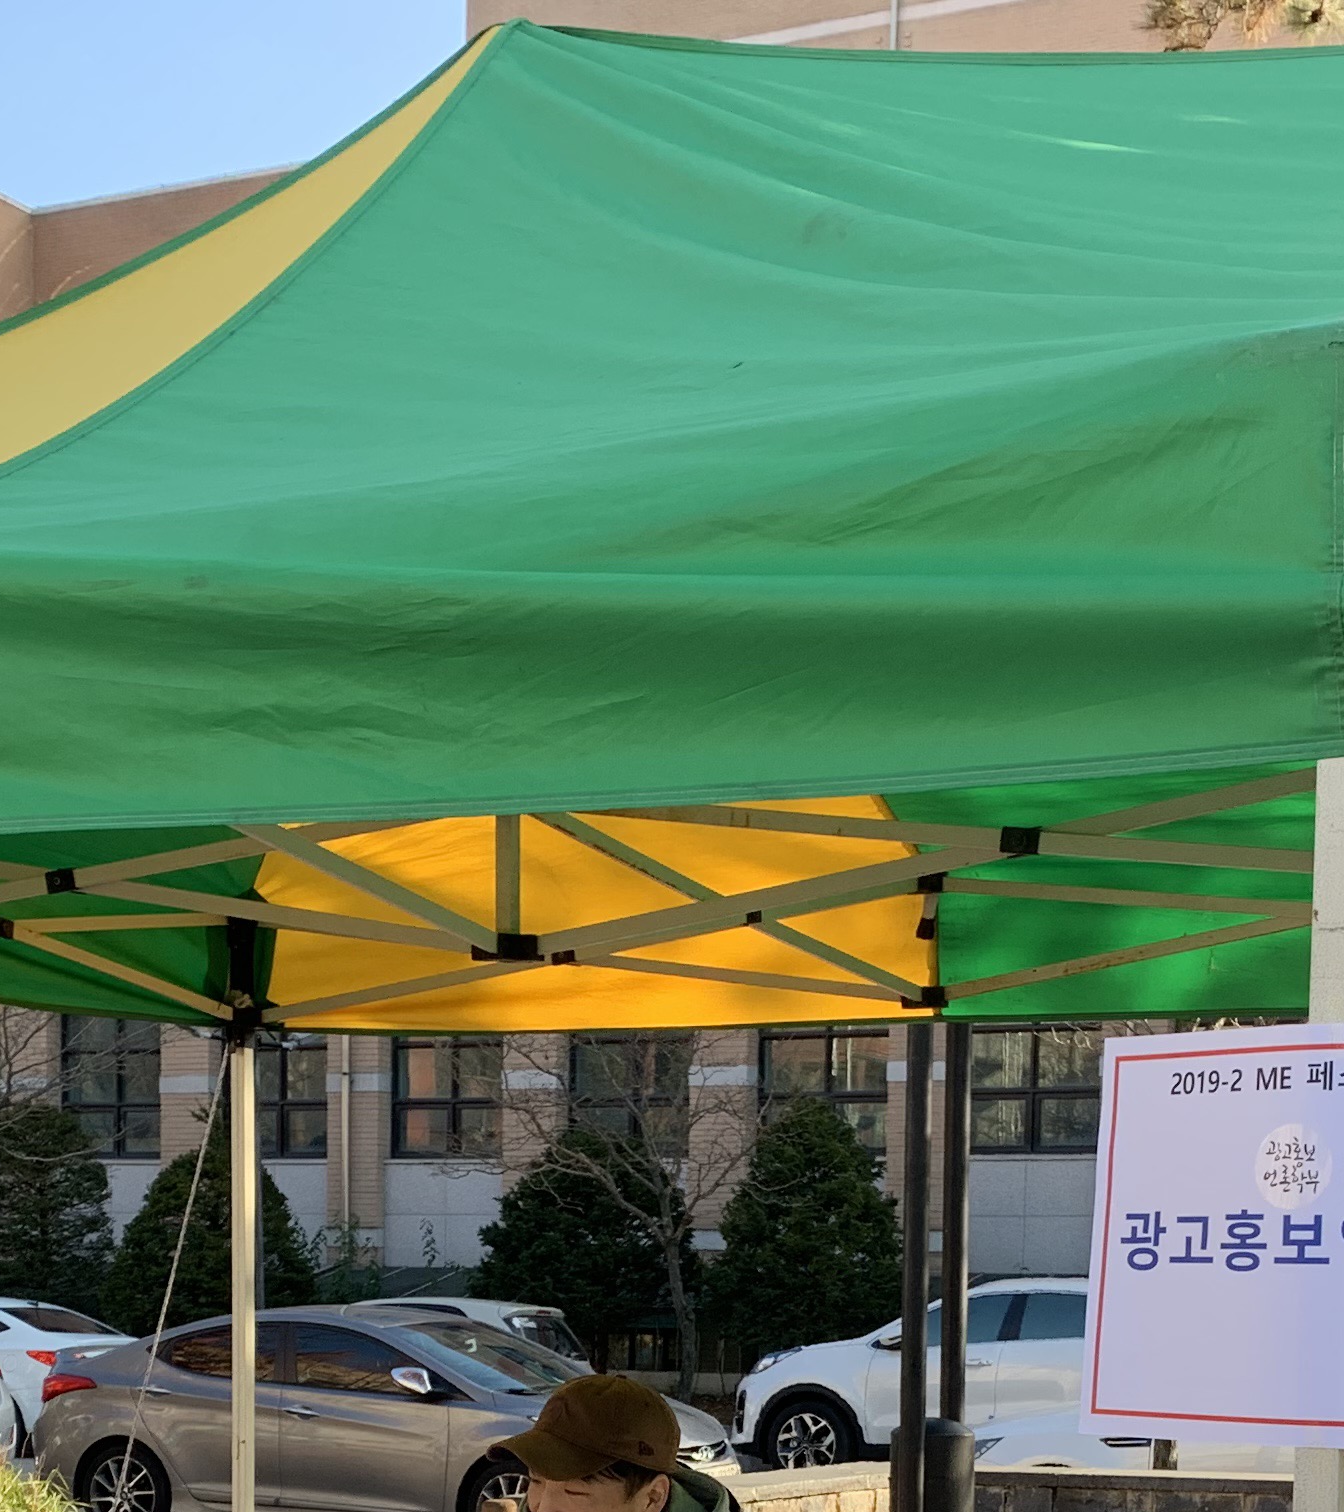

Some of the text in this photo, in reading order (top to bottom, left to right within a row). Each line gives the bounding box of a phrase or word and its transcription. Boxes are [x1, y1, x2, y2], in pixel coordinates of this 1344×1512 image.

[1170, 1069, 1243, 1096] 2019-2
[1255, 1066, 1293, 1092] ME
[1265, 1136, 1316, 1168] 광고홍보
